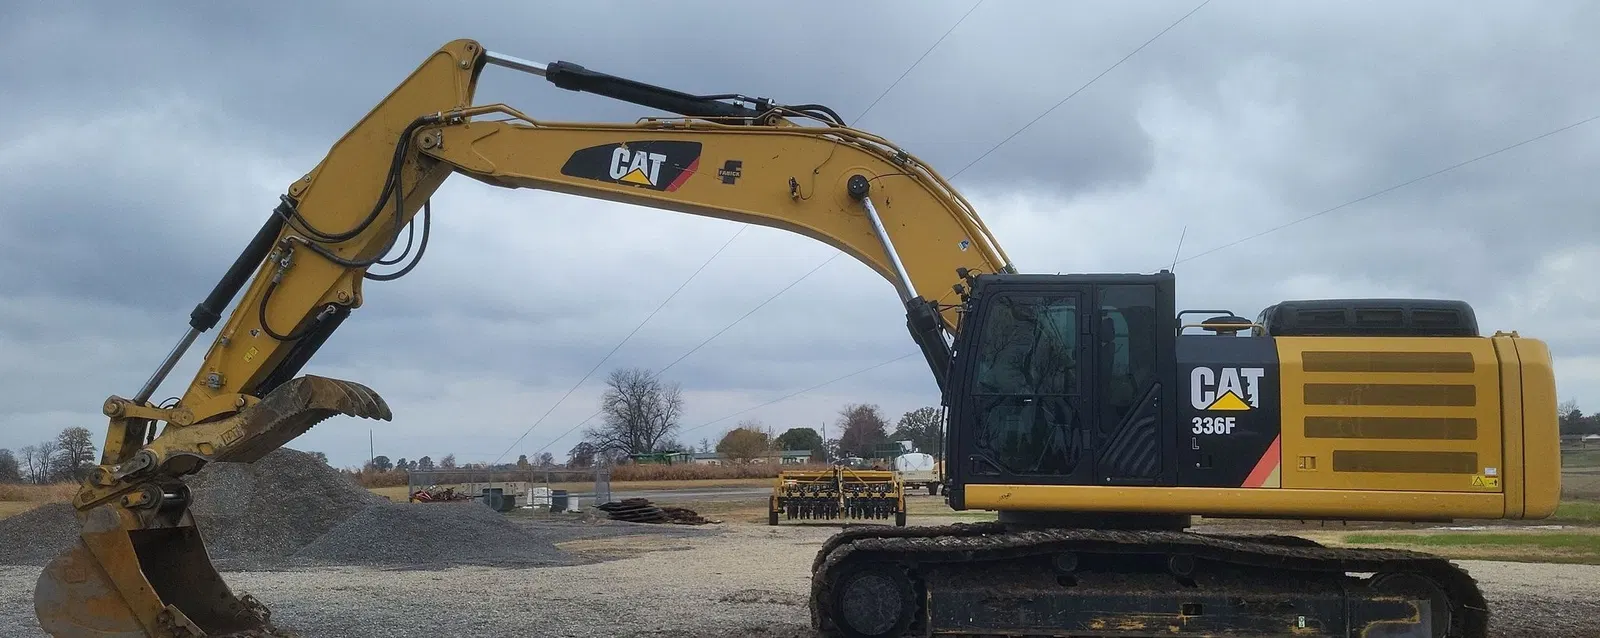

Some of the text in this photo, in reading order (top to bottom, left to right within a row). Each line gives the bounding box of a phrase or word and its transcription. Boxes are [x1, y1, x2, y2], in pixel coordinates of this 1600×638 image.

[609, 147, 667, 187] CAT
[1190, 366, 1265, 411] CAT
[1191, 416, 1236, 435] 336F
